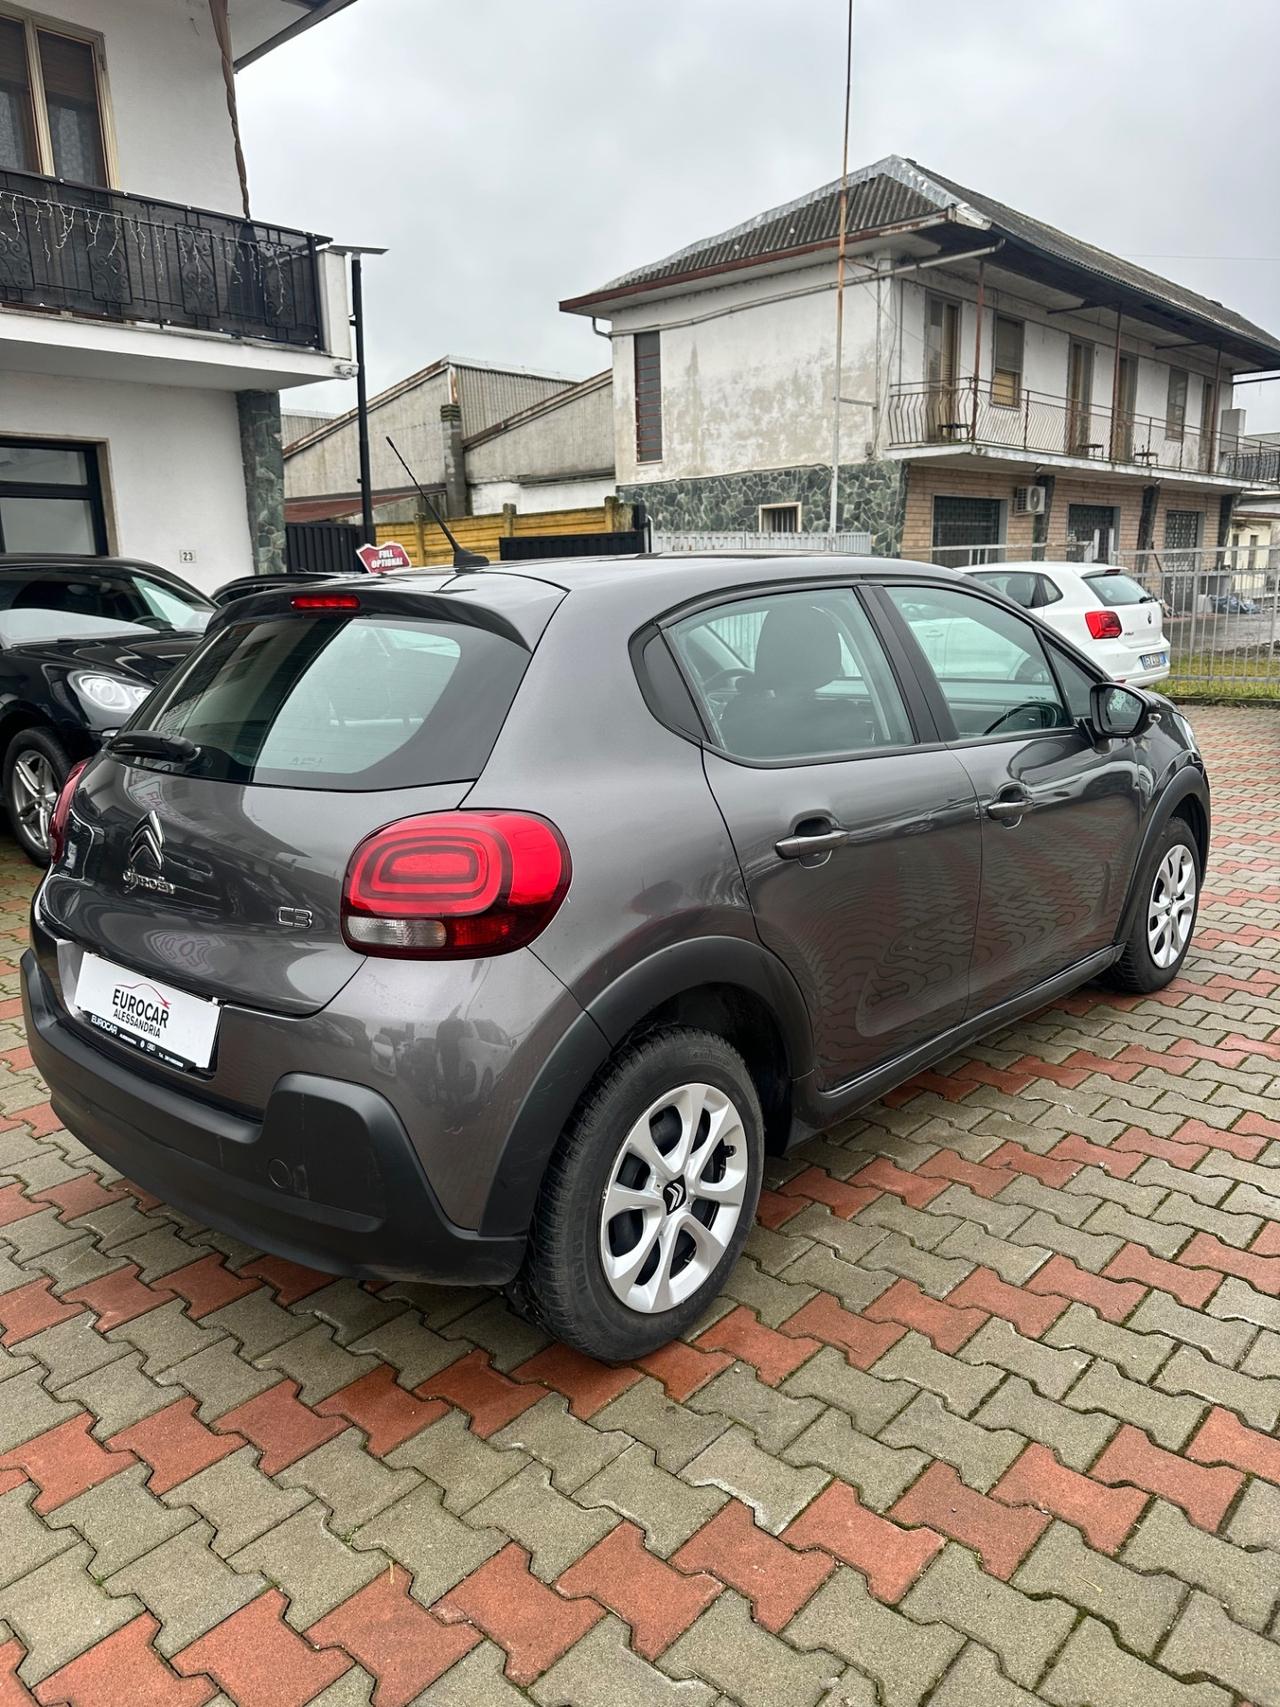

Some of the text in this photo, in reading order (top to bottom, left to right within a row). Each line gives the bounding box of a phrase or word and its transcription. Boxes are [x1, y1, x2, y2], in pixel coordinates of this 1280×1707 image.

[182, 551, 193, 561] 23
[371, 557, 404, 569] OPTIONAL
[378, 549, 394, 559] FULL
[277, 906, 313, 928] C3
[112, 988, 170, 1029] EUROCAR
[91, 1014, 118, 1035] EUROCAR
[113, 1008, 161, 1039] ALESSANDRIA
